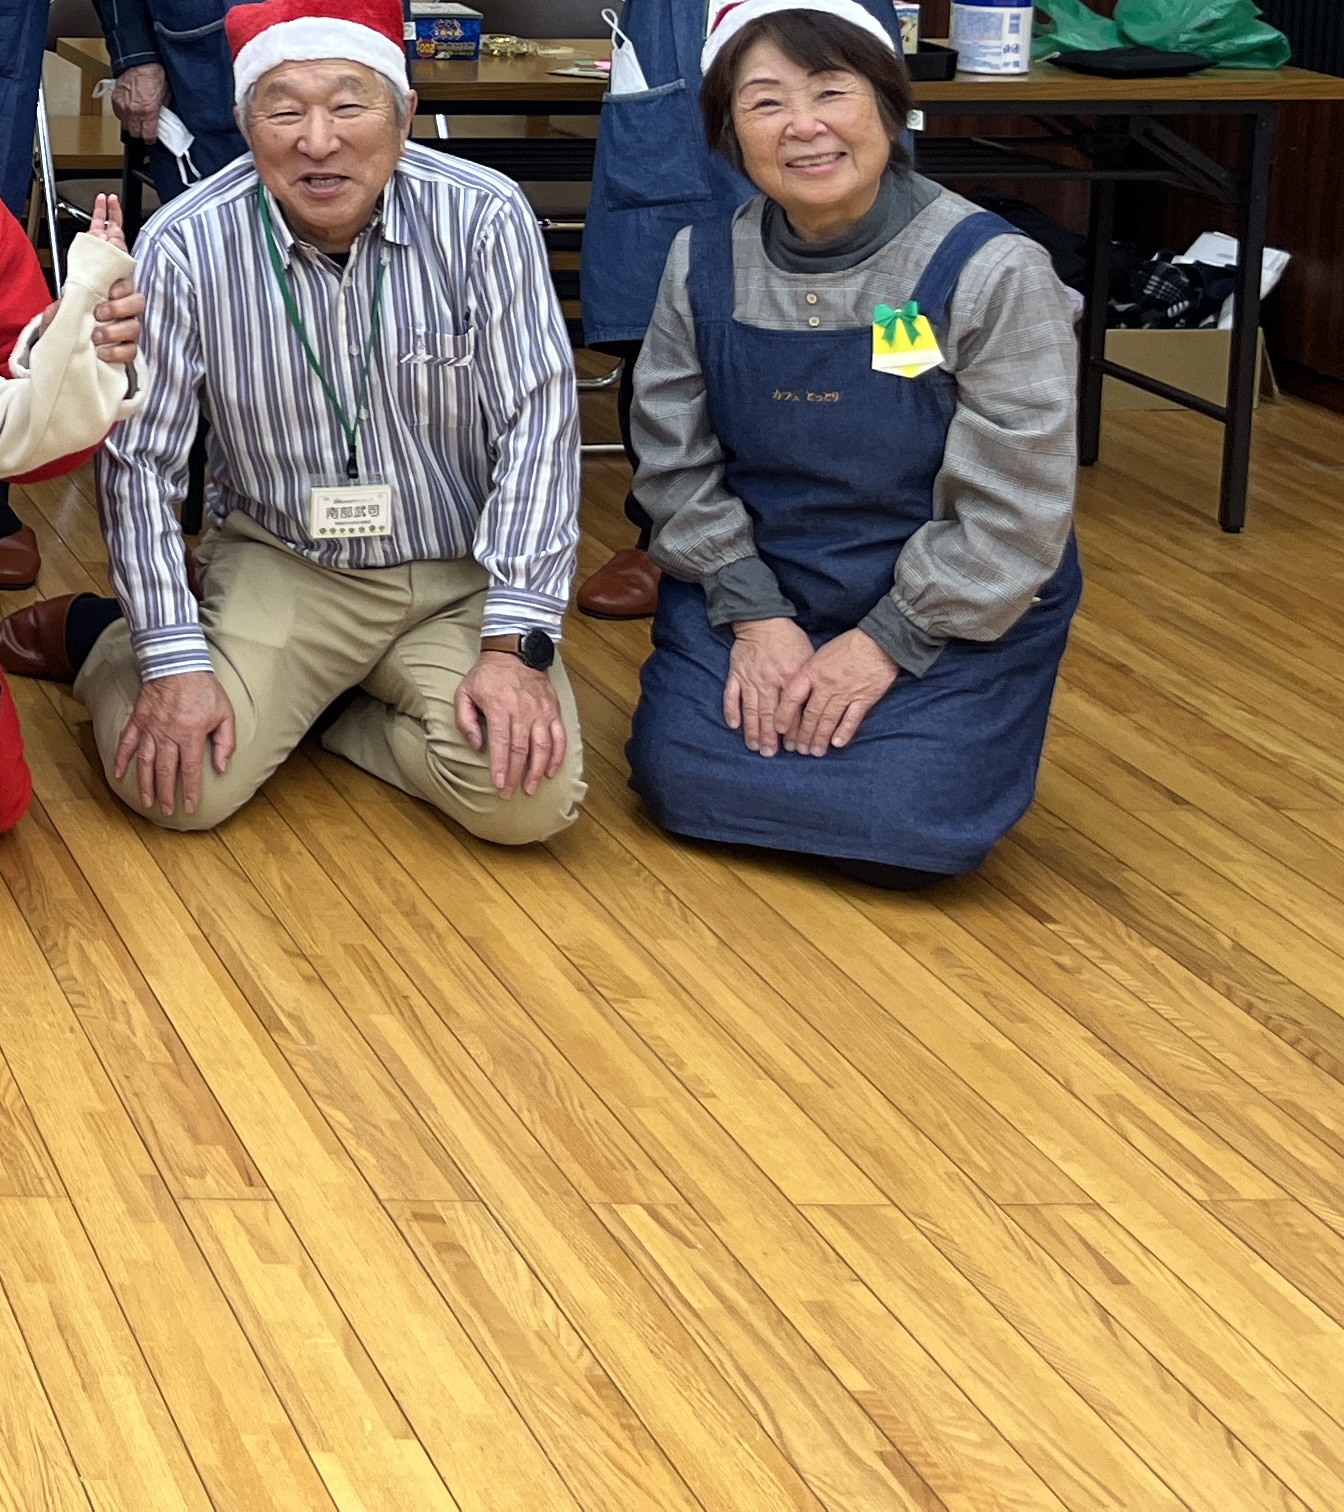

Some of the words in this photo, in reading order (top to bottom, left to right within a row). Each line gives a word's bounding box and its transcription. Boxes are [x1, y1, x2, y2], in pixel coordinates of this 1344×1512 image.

[772, 389, 800, 401] カフェ
[805, 389, 840, 403] とっとり
